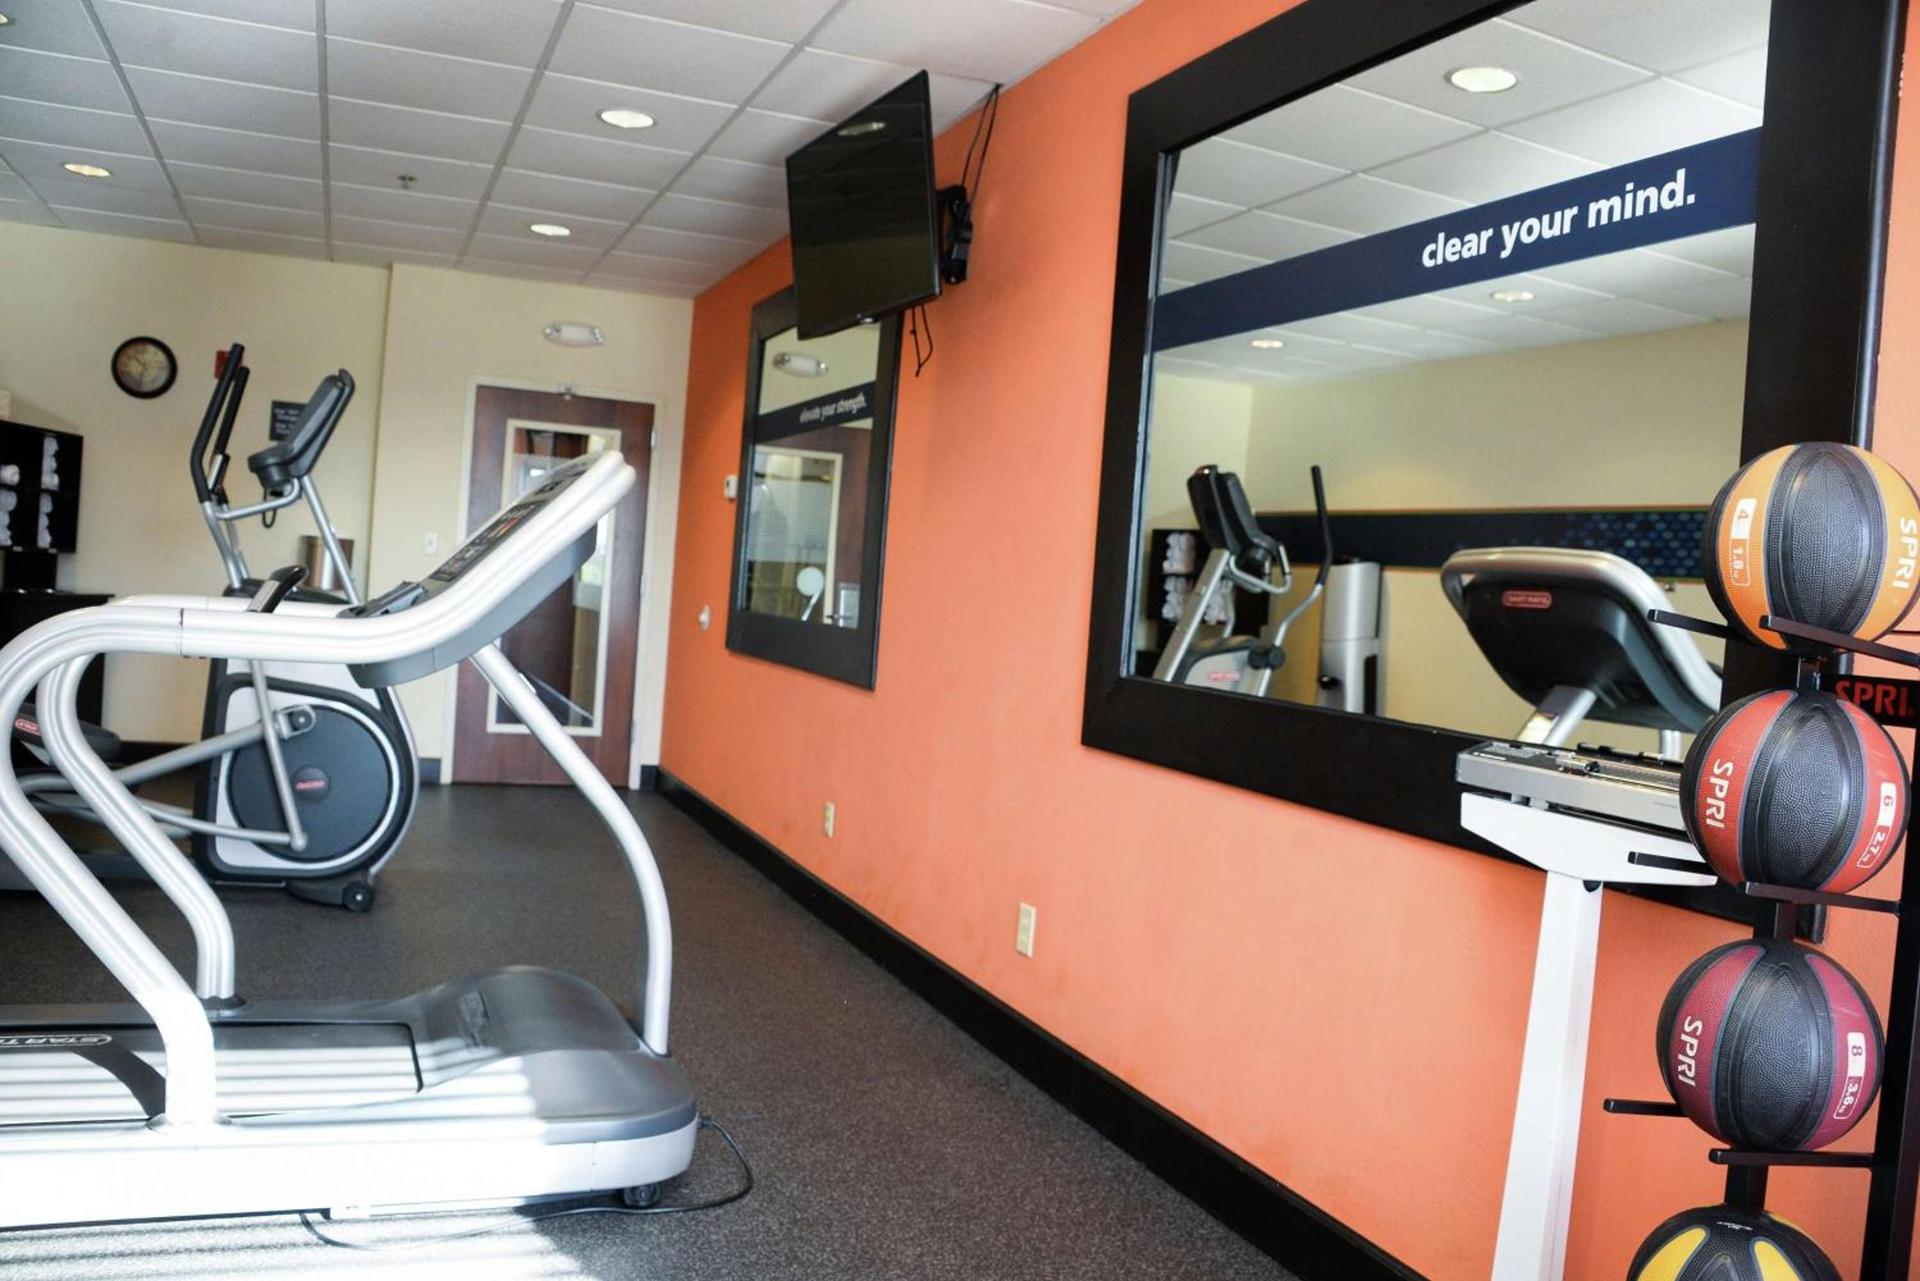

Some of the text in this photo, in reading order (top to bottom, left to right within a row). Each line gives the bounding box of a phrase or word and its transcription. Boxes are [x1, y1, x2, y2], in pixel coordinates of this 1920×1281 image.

[1421, 168, 1696, 268] clear your mind.
[821, 403, 837, 422] your
[1738, 509, 1750, 520] 4
[1892, 516, 1917, 589] SPRI
[1835, 680, 1908, 717] SPRI
[1705, 758, 1734, 829] SPRI
[1883, 795, 1895, 807] 6
[1677, 1015, 1703, 1087] SPRI
[1851, 1045, 1863, 1057] 8
